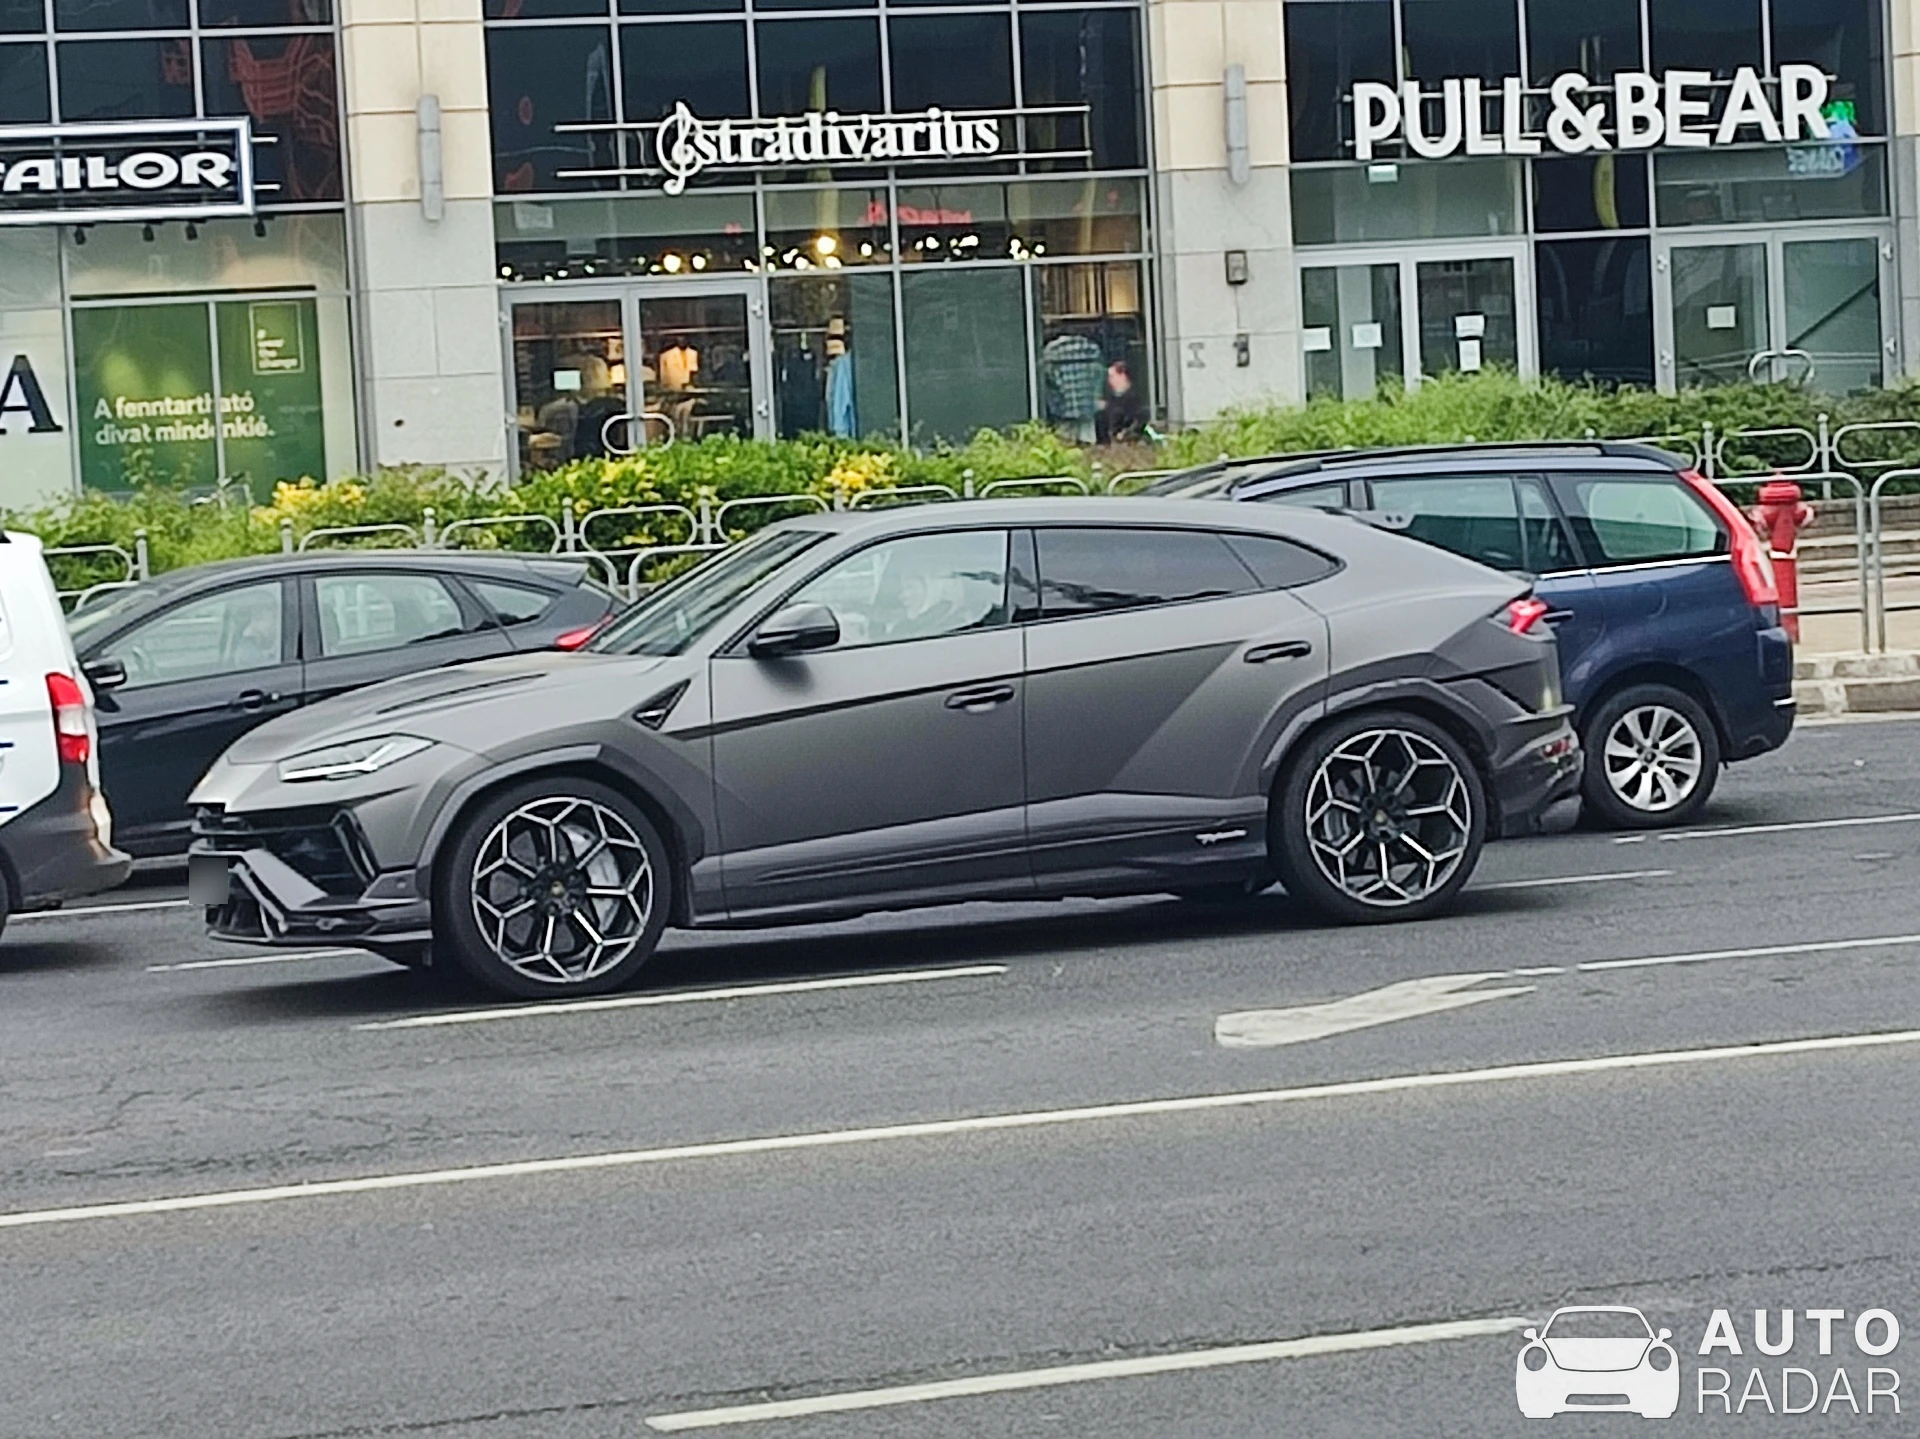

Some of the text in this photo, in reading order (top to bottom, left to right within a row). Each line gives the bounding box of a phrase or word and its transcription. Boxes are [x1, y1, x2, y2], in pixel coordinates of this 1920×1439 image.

[1352, 64, 1831, 160] PULL&BEAR
[697, 106, 1000, 166] stradivarius
[0, 152, 233, 192] AILOR
[94, 398, 112, 419] A
[95, 424, 152, 446] divat
